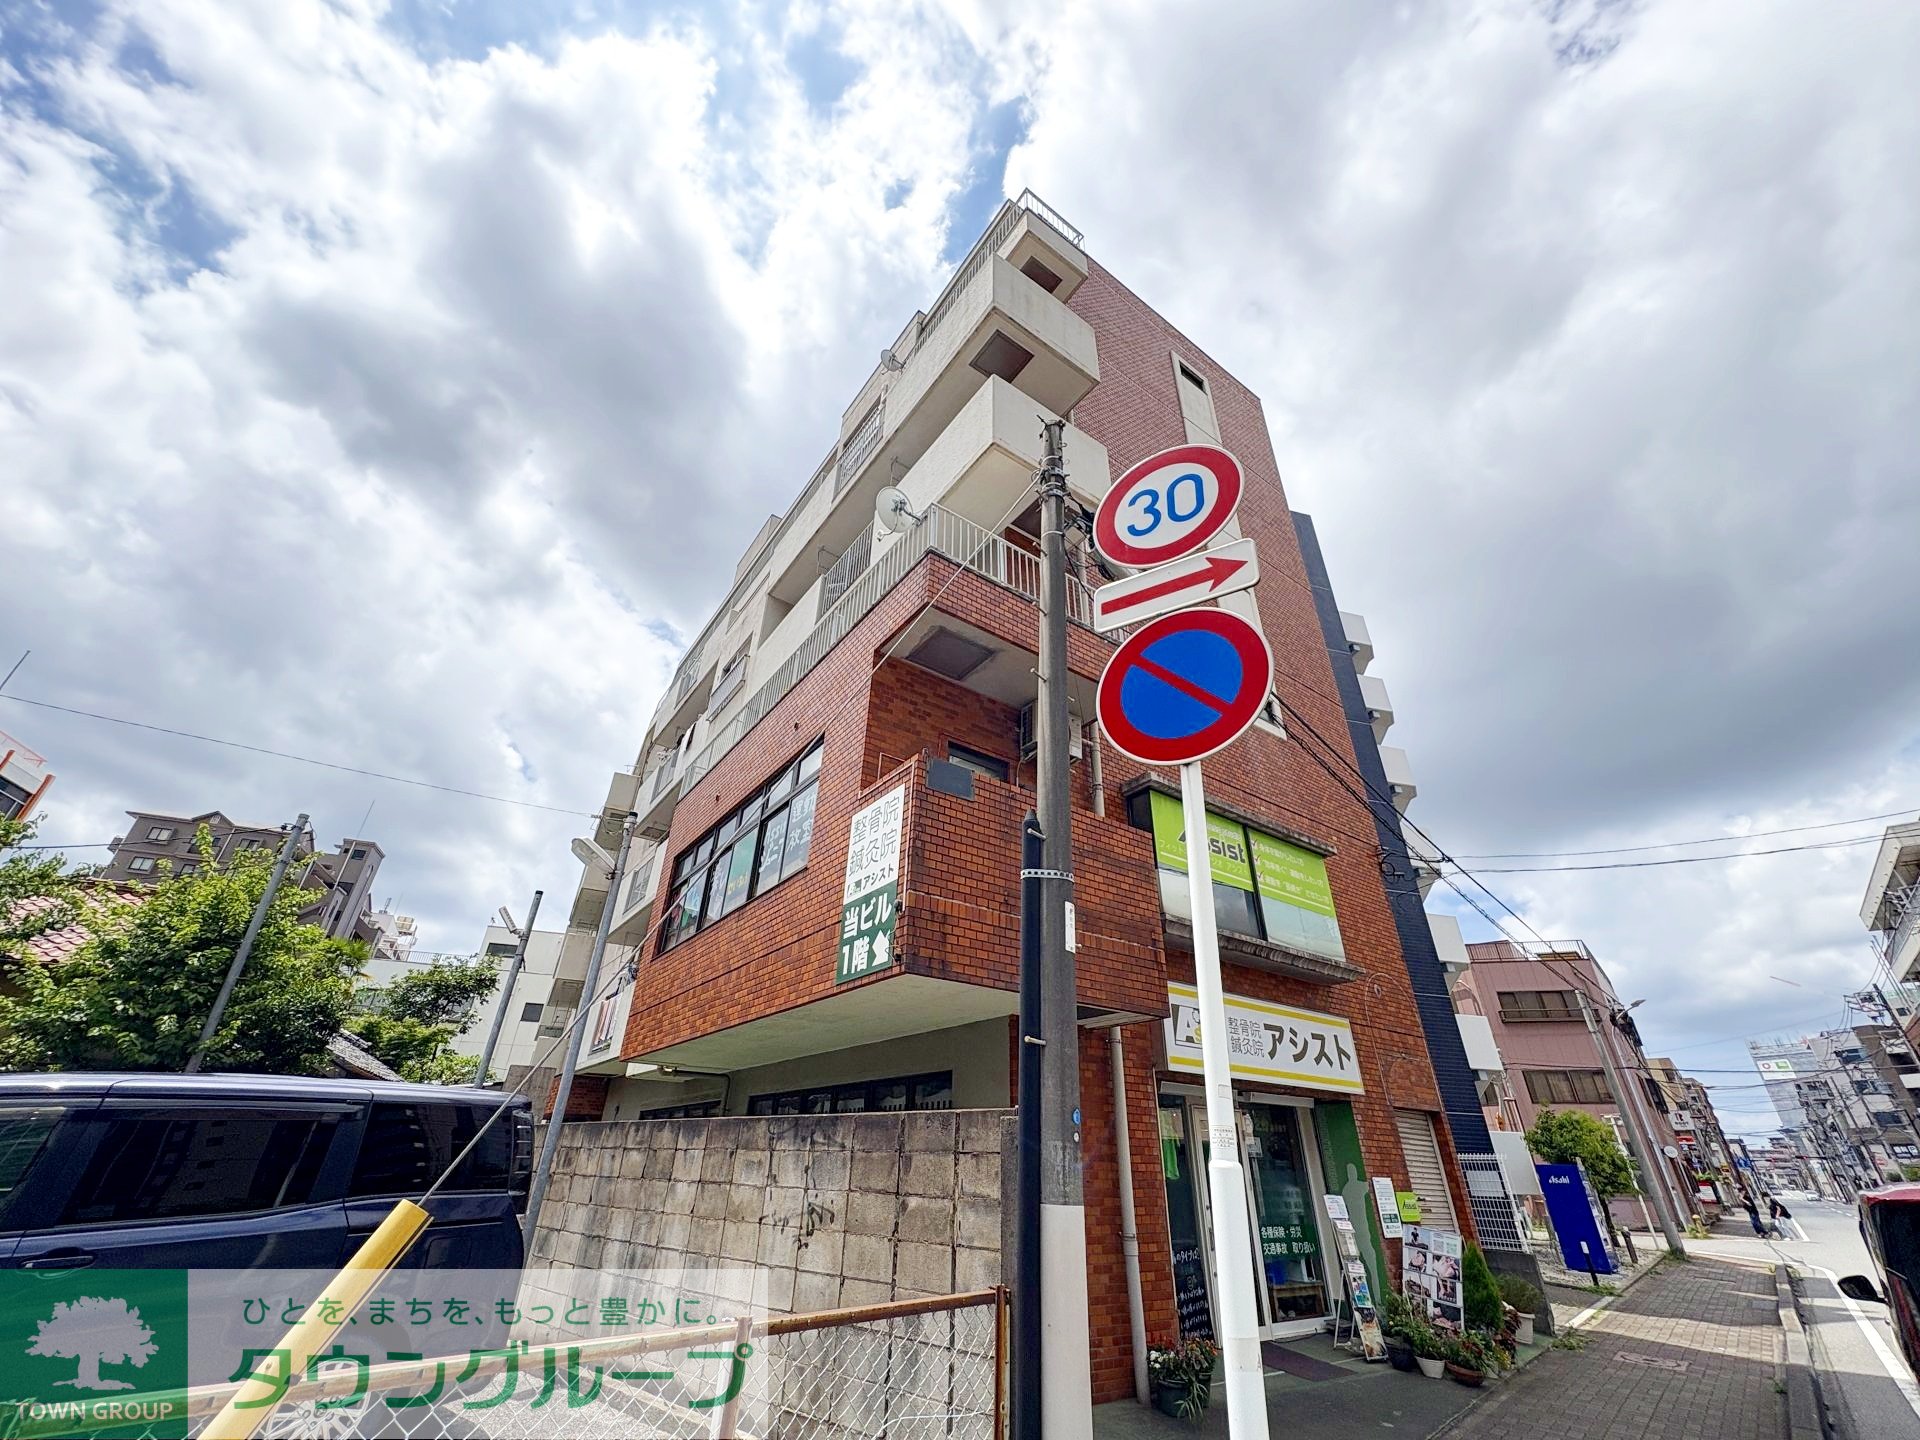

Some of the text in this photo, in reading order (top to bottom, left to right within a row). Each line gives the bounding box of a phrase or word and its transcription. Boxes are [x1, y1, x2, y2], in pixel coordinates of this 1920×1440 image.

[1127, 474, 1205, 537] 30
[852, 796, 900, 846] 整骨院
[849, 828, 897, 877] 鍼灸院
[1178, 830, 1246, 864] sist
[862, 863, 895, 891] アシスト
[843, 892, 892, 940] 当ビル
[842, 935, 870, 975] 1階
[1228, 1017, 1261, 1039] 整骨院
[1230, 1036, 1264, 1058] 鍼灸院
[1263, 1022, 1351, 1070] アシスト
